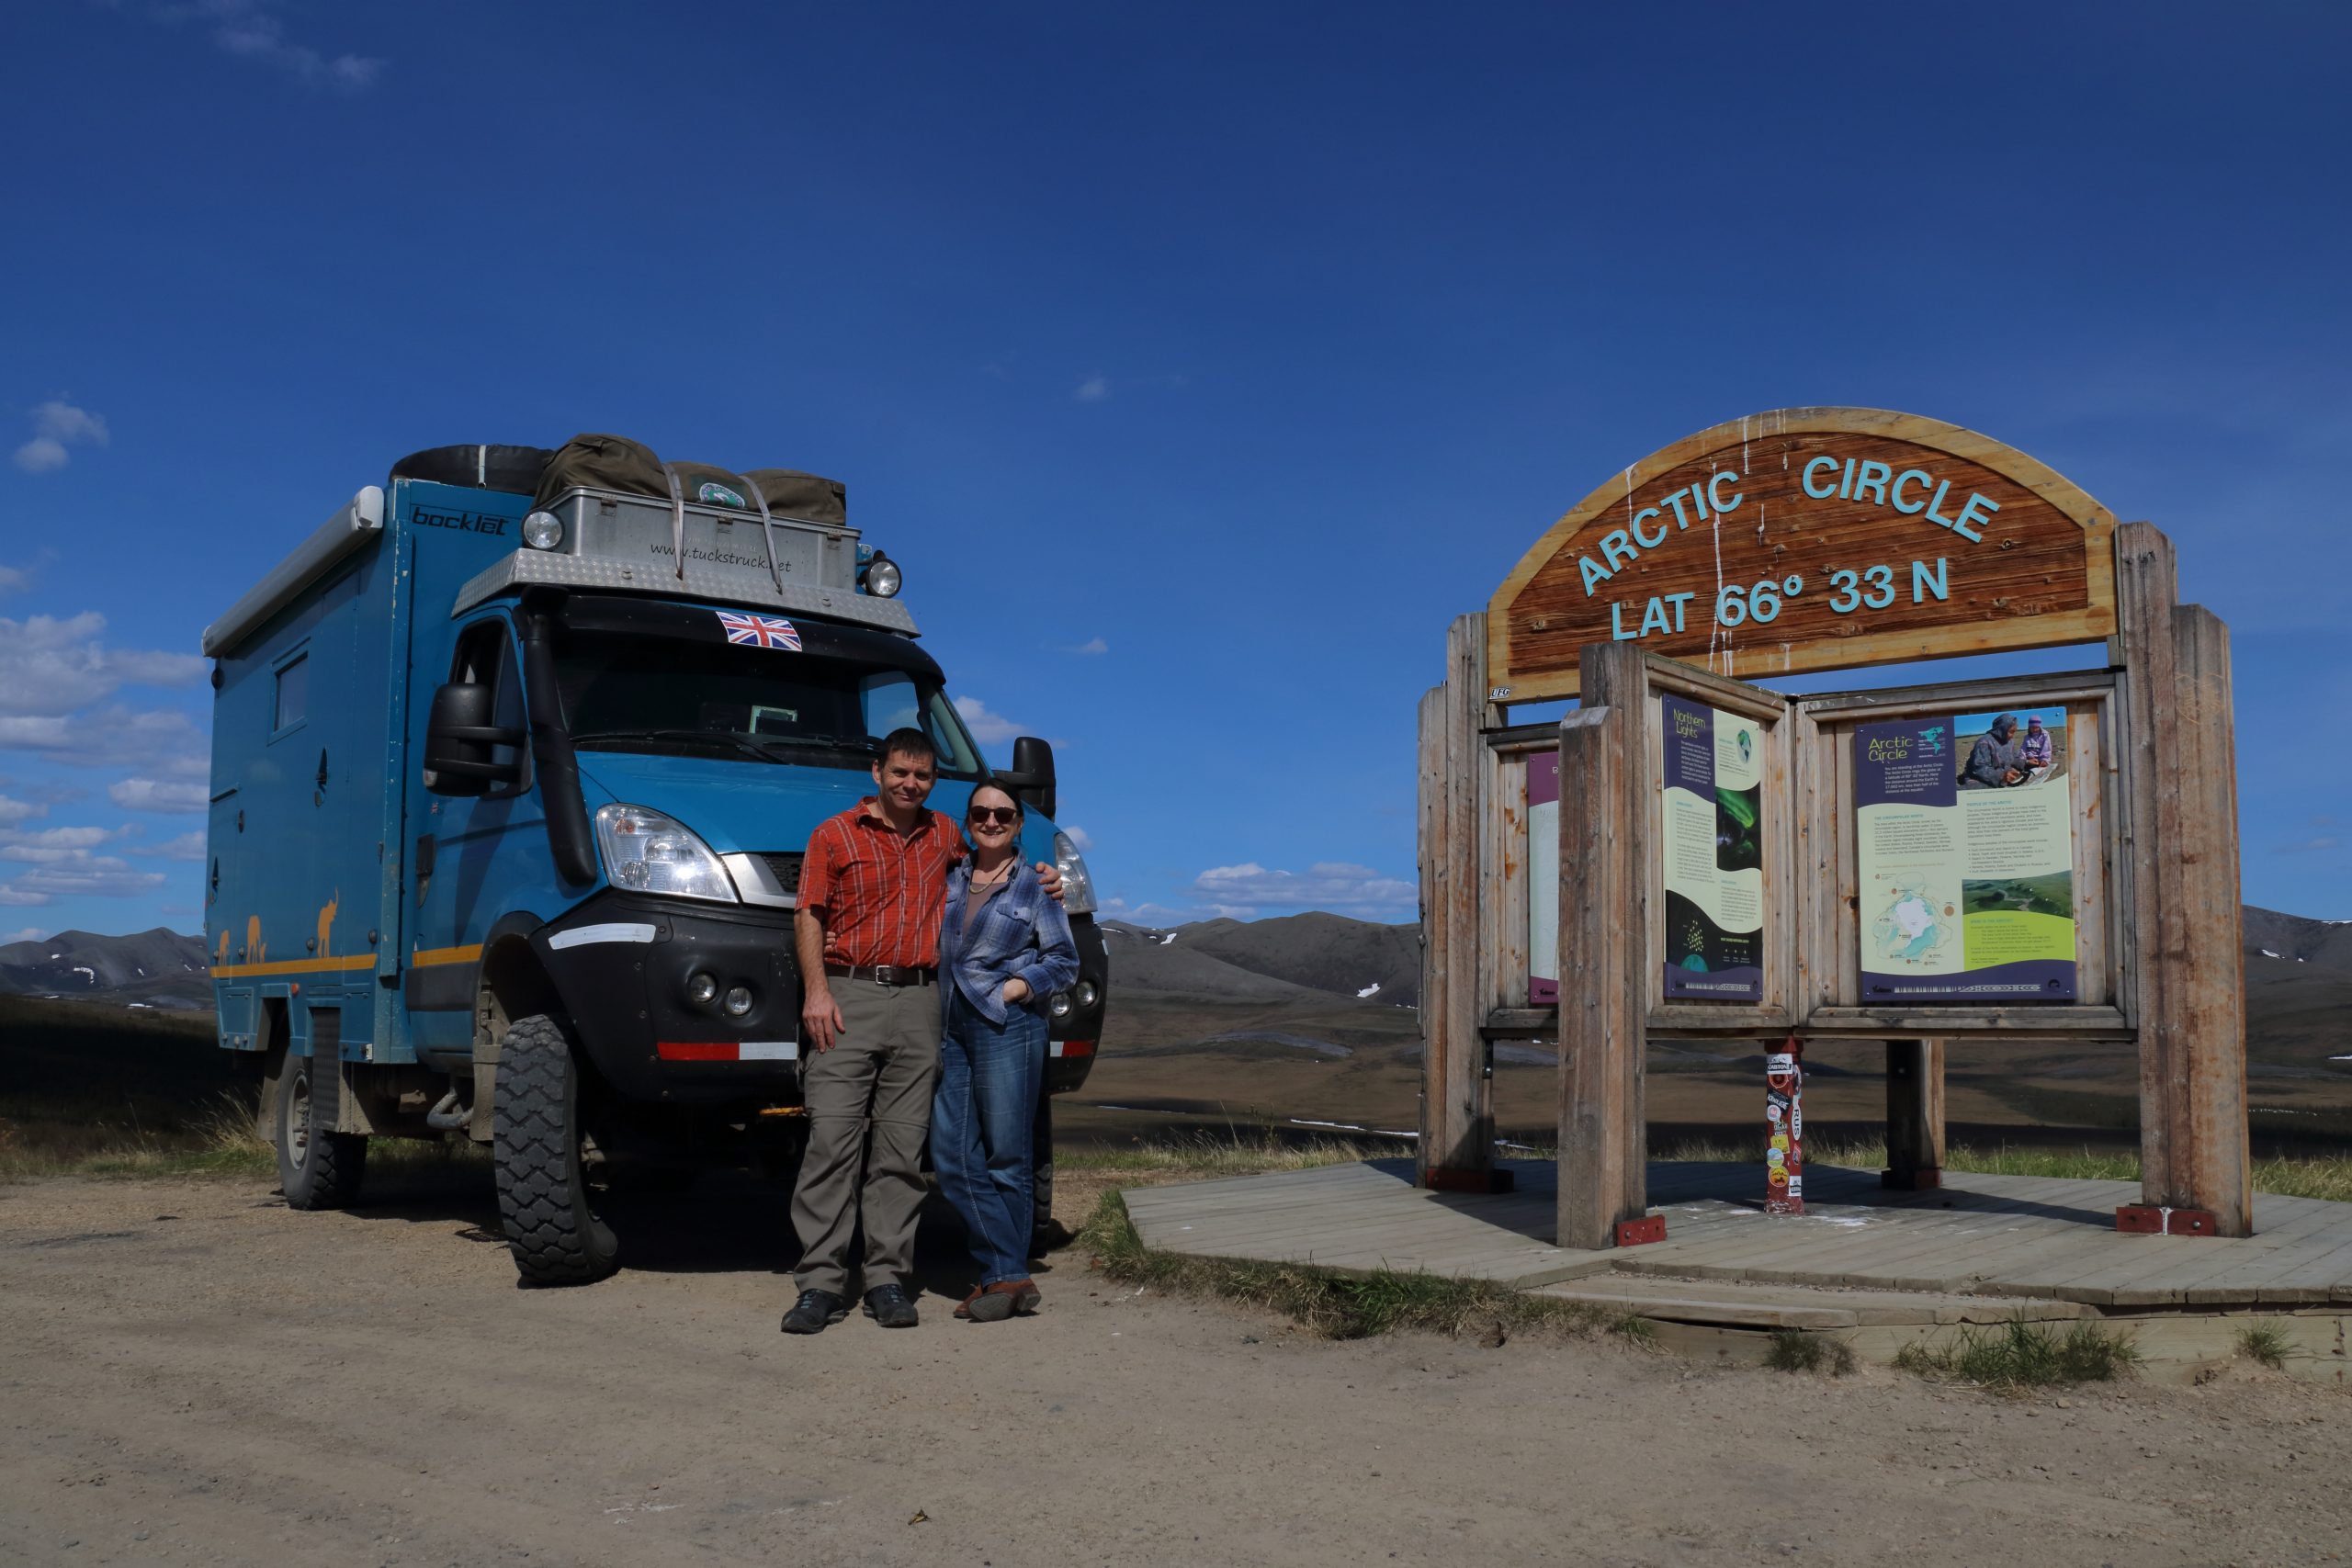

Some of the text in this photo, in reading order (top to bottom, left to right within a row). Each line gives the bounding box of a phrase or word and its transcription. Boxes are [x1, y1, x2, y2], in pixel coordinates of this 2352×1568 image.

[412, 506, 510, 536] bocklet
[1579, 456, 2000, 597] ARCTIC CIRCLE
[1612, 592, 1694, 641] LAT
[1829, 566, 1896, 614] 33
[1911, 558, 1948, 604] N
[1674, 707, 1705, 729] Northern
[1676, 721, 1698, 739] Lights
[1869, 736, 1913, 750] Arctic
[1869, 749, 1907, 761] Circle
